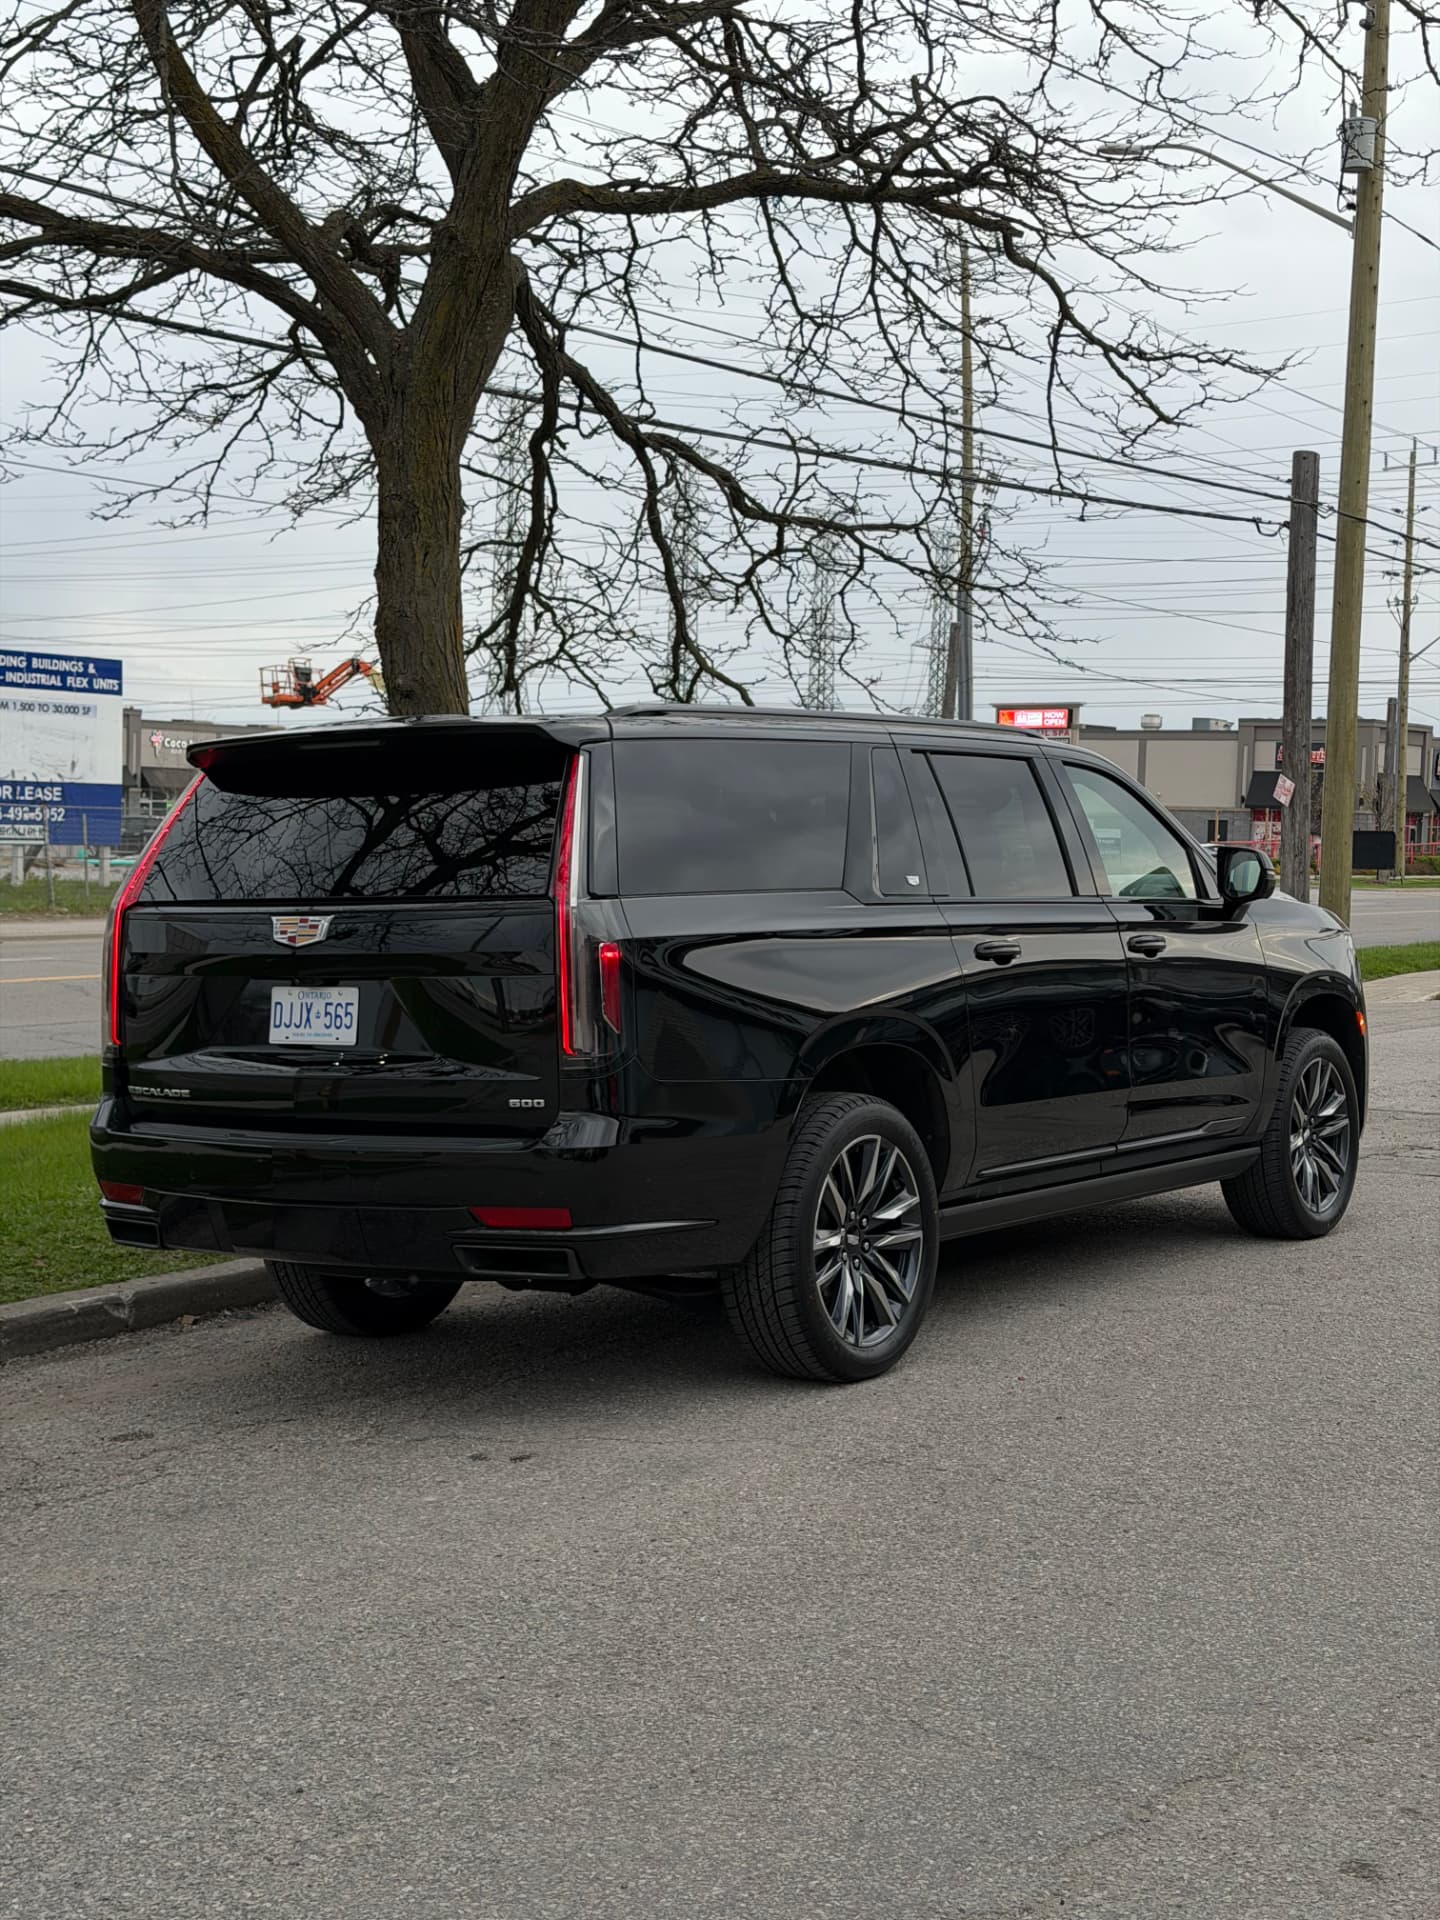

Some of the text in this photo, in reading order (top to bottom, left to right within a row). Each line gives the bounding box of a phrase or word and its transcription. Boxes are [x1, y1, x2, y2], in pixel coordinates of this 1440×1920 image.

[32, 657, 84, 673] BUILDINGS
[88, 663, 97, 674] &
[5, 671, 62, 686] INDUSTRIAL
[67, 676, 89, 688] FLEX
[93, 678, 120, 690] UNITS
[38, 703, 50, 712] TO
[1044, 711, 1065, 719] NOW
[164, 737, 187, 748] Coco
[0, 785, 63, 801] R LEASE
[298, 991, 332, 1000] ONTARIO
[273, 1002, 354, 1030] DJJX 565
[509, 1099, 545, 1108] 600
